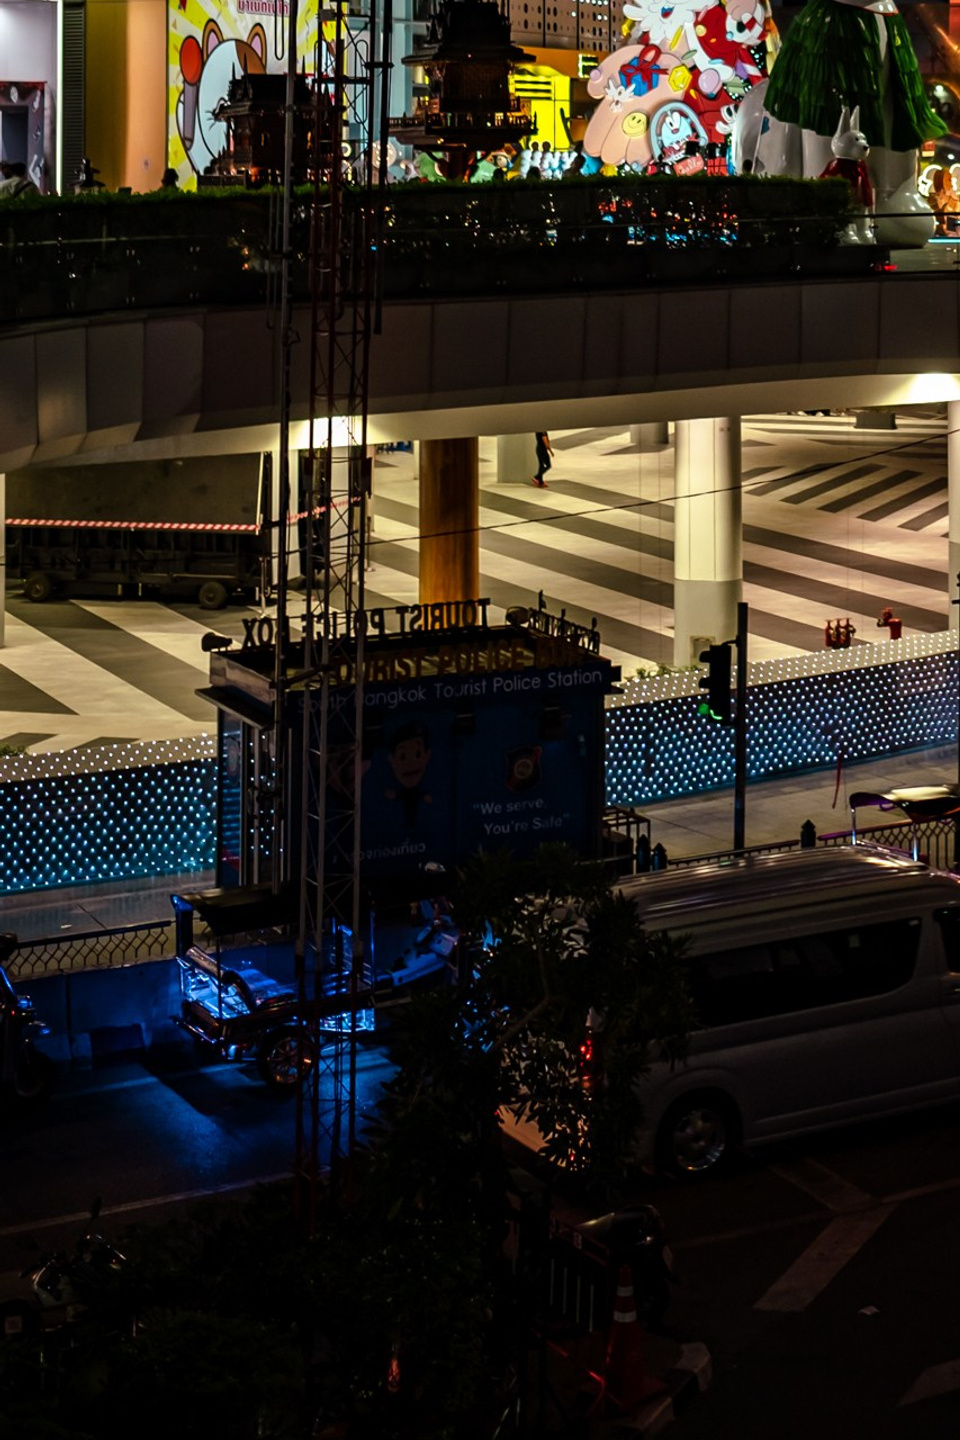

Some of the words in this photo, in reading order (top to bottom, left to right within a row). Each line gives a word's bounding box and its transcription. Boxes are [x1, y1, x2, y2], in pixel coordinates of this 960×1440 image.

[437, 638, 527, 677] POLICE
[356, 684, 427, 710] angkok
[434, 678, 488, 700] Tourist
[492, 672, 544, 695] Police
[547, 667, 604, 690] Station
